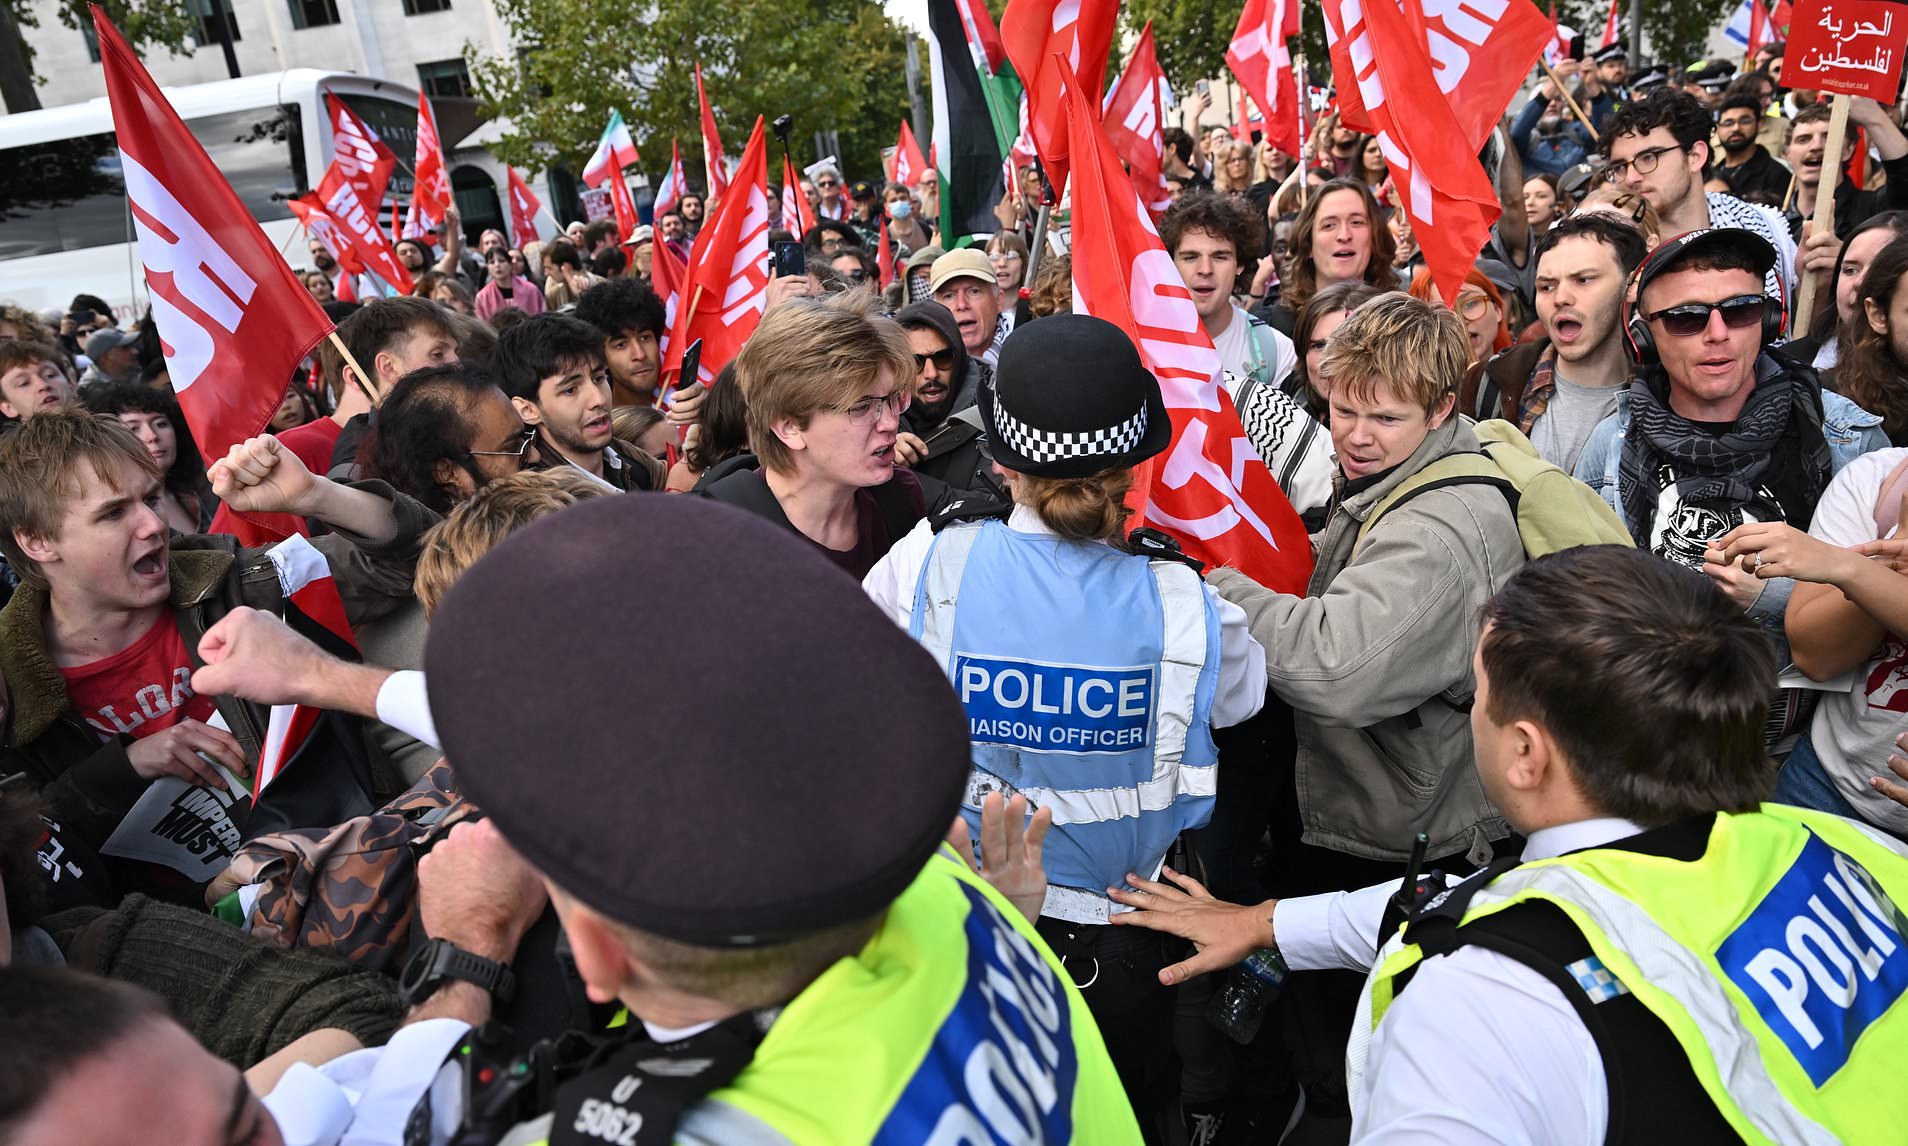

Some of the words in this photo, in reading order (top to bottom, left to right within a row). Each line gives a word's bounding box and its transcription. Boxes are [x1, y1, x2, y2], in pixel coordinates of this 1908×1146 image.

[1818, 5, 1893, 42] الحرية
[1800, 40, 1892, 75] لفلسطين
[86, 666, 194, 743] LOR
[961, 665, 1147, 719] POLICE
[970, 717, 1042, 743] IAISON
[1049, 726, 1143, 746] OFFICER
[151, 806, 230, 865] MUST
[611, 1074, 642, 1104] U
[574, 1098, 642, 1146] 5062
